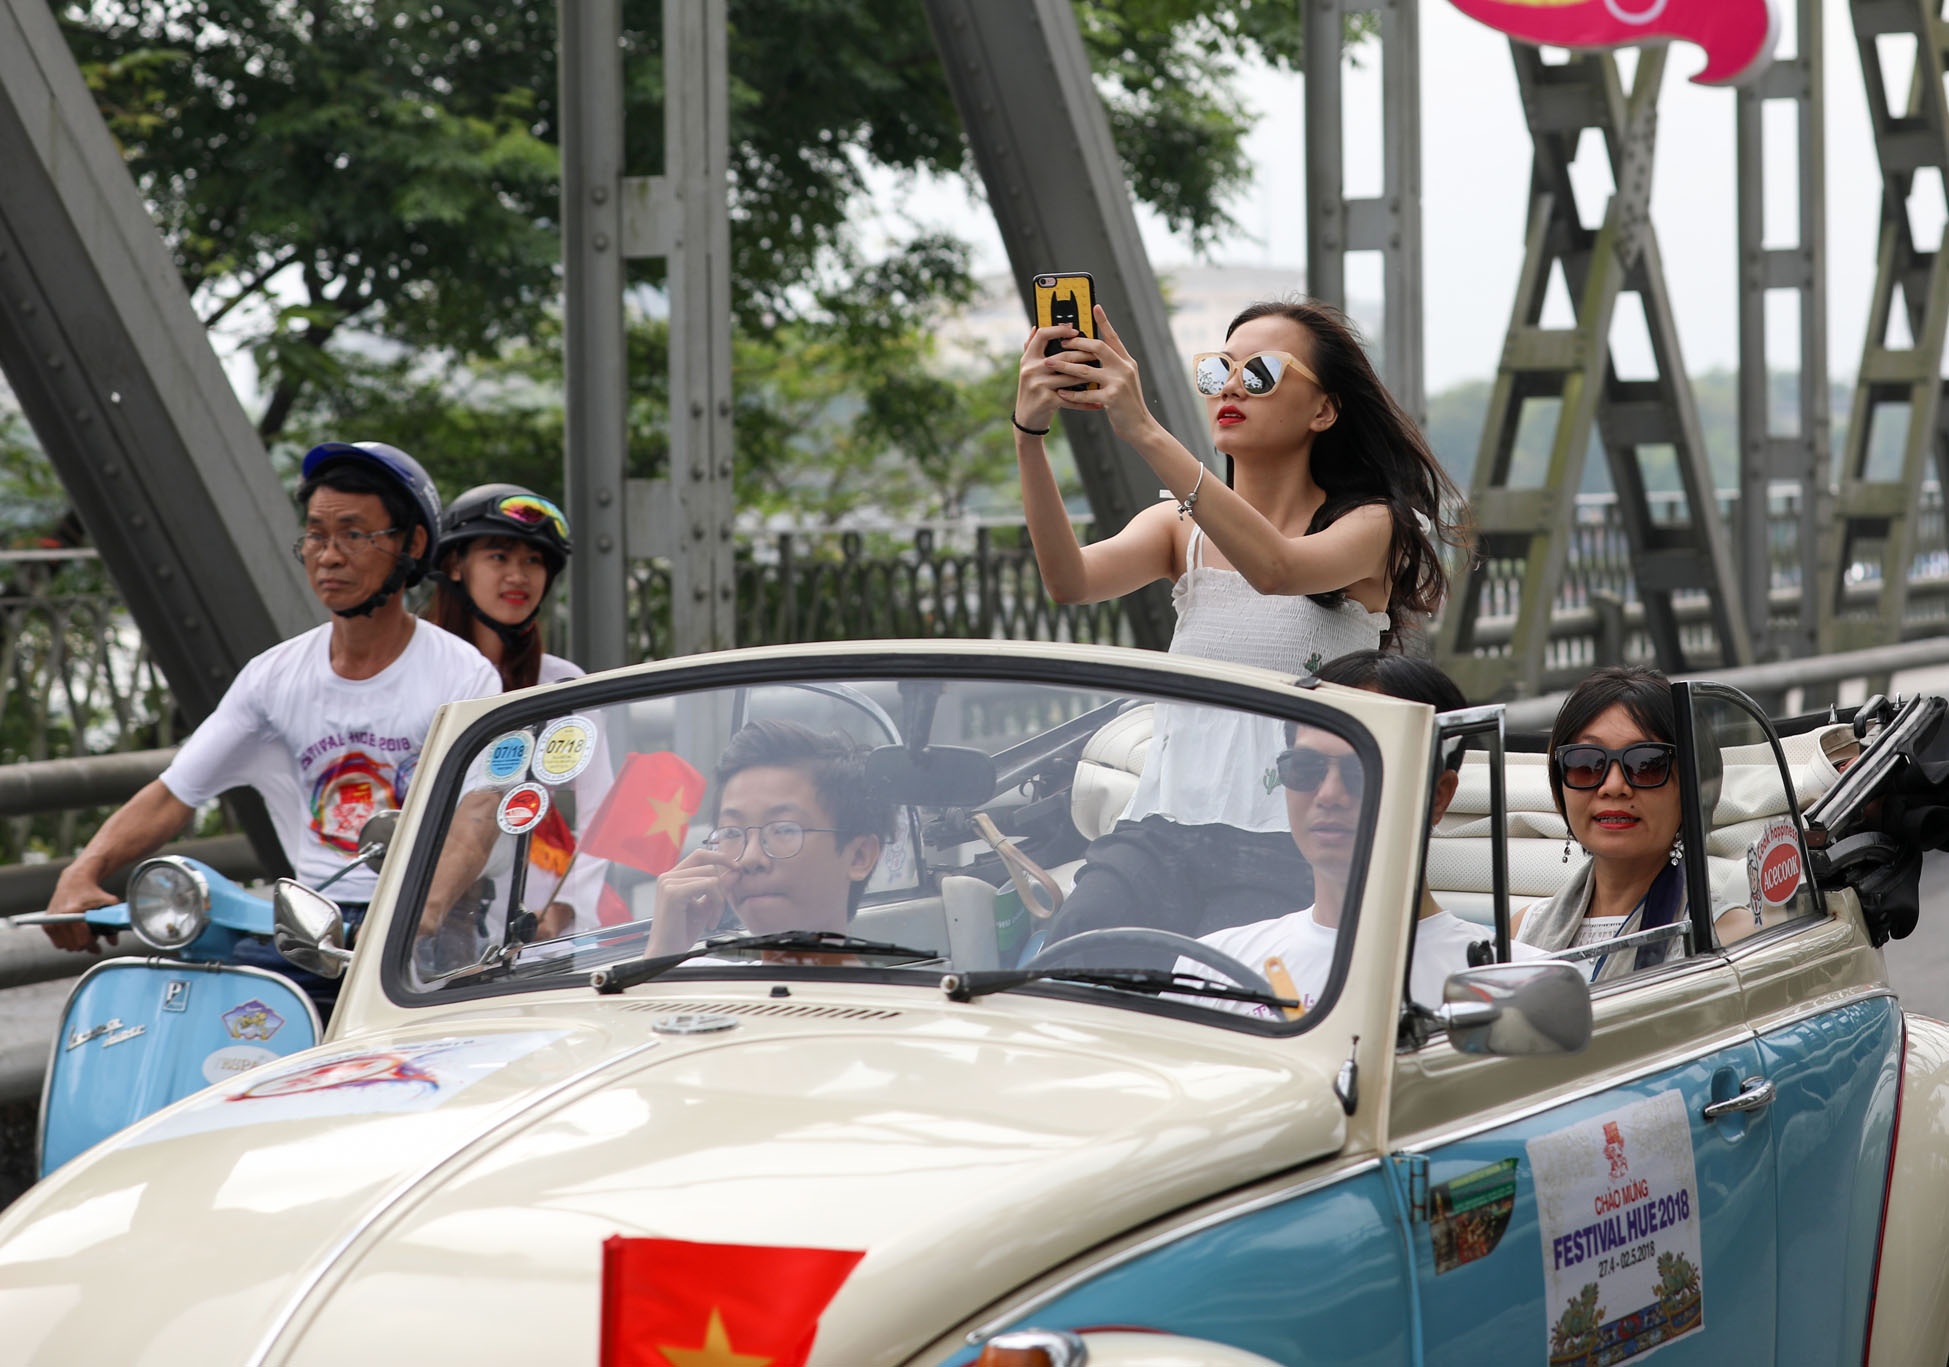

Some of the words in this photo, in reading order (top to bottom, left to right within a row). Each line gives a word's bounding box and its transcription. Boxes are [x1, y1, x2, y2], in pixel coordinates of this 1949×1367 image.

[379, 737, 411, 752] 2018
[494, 745, 525, 759] 07/18
[546, 739, 585, 754] 07/18
[1769, 823, 1798, 843] happiness
[1594, 1186, 1621, 1216] CHÀO
[1553, 1214, 1627, 1271] FESTIVAL
[1658, 1188, 1690, 1231] 2018
[1598, 1256, 1615, 1279] 27.4
[1620, 1240, 1656, 1270] 02.5.2018
